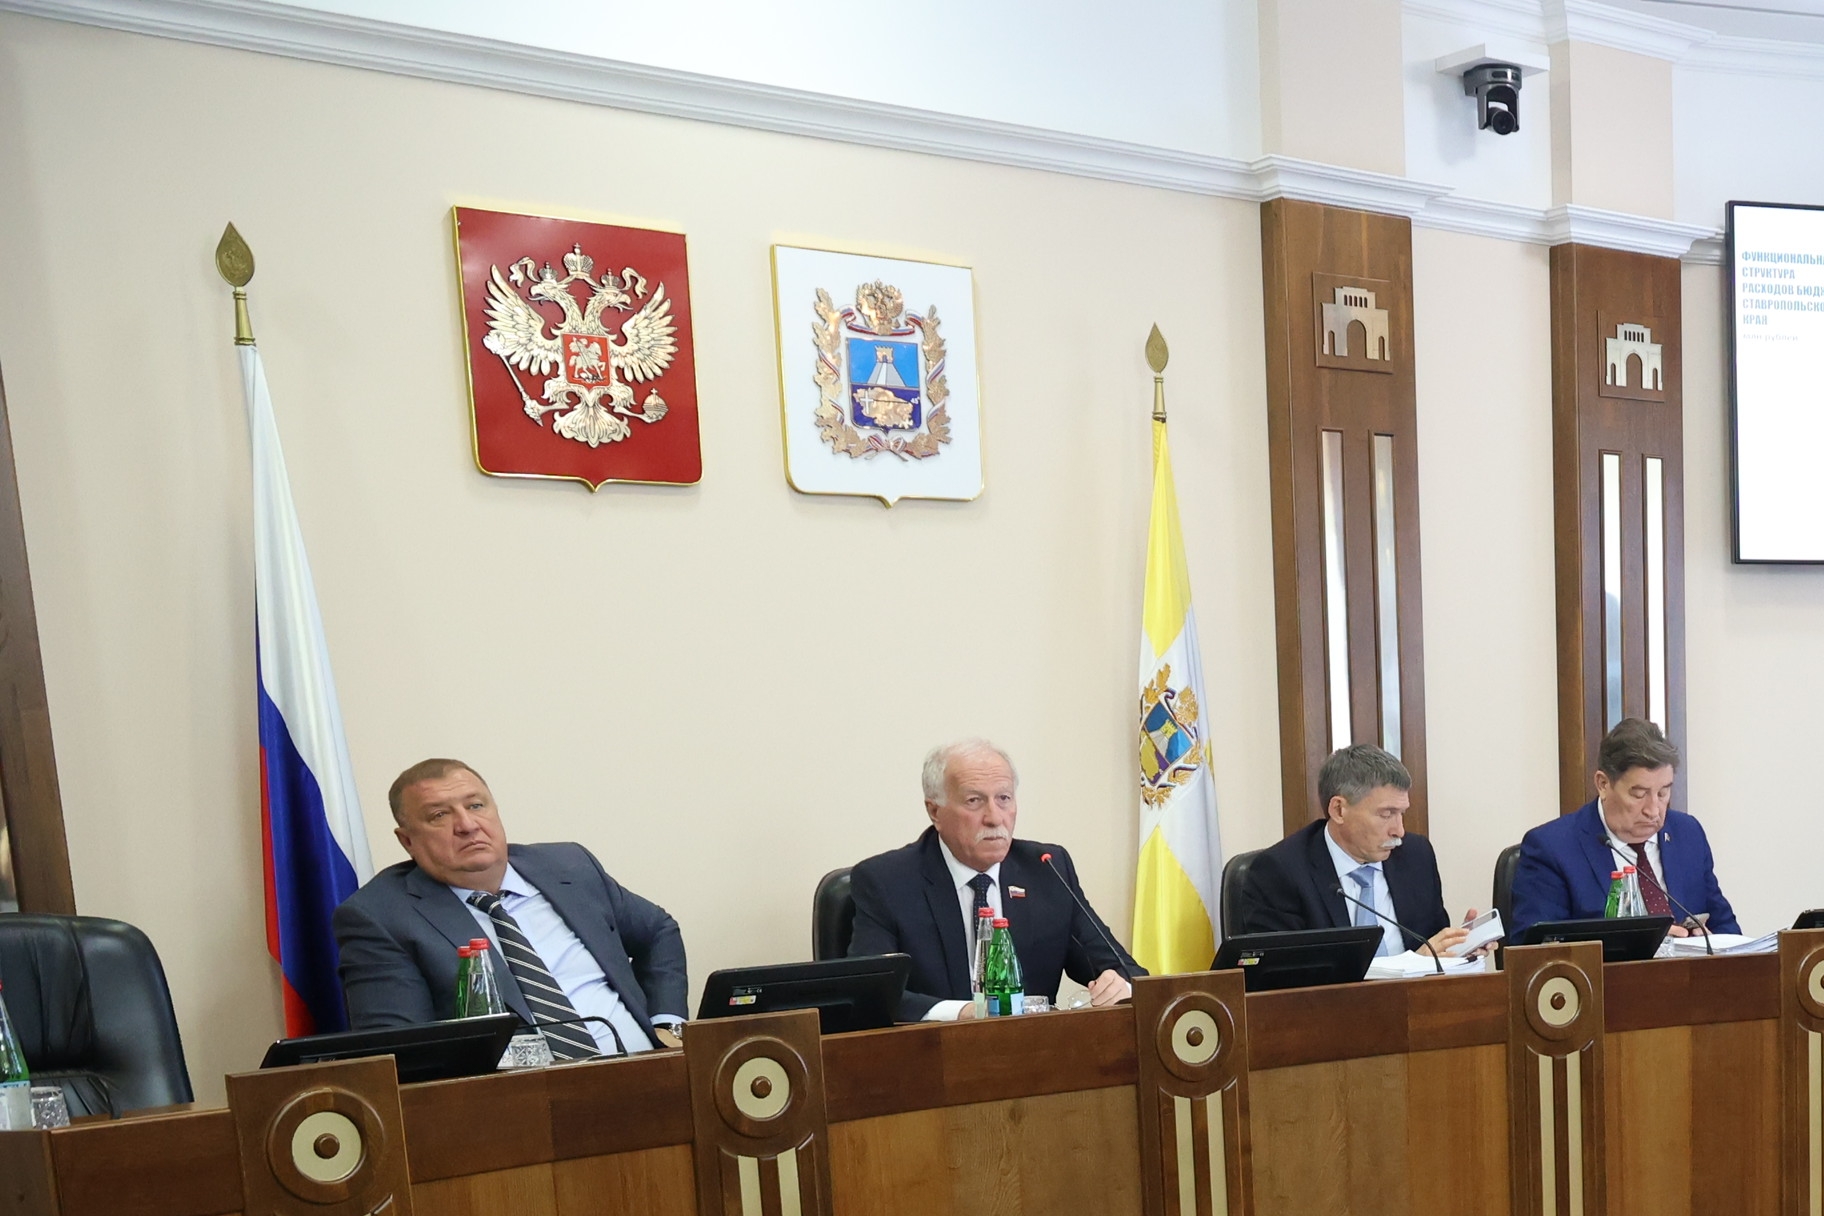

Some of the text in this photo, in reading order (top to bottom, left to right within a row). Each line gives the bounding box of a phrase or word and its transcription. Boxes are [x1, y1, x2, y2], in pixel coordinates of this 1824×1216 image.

[1741, 266, 1796, 279] СТРУКТУРА
[1742, 282, 1795, 295] РАСХОДОВ
[1742, 314, 1768, 325] КРАЯ
